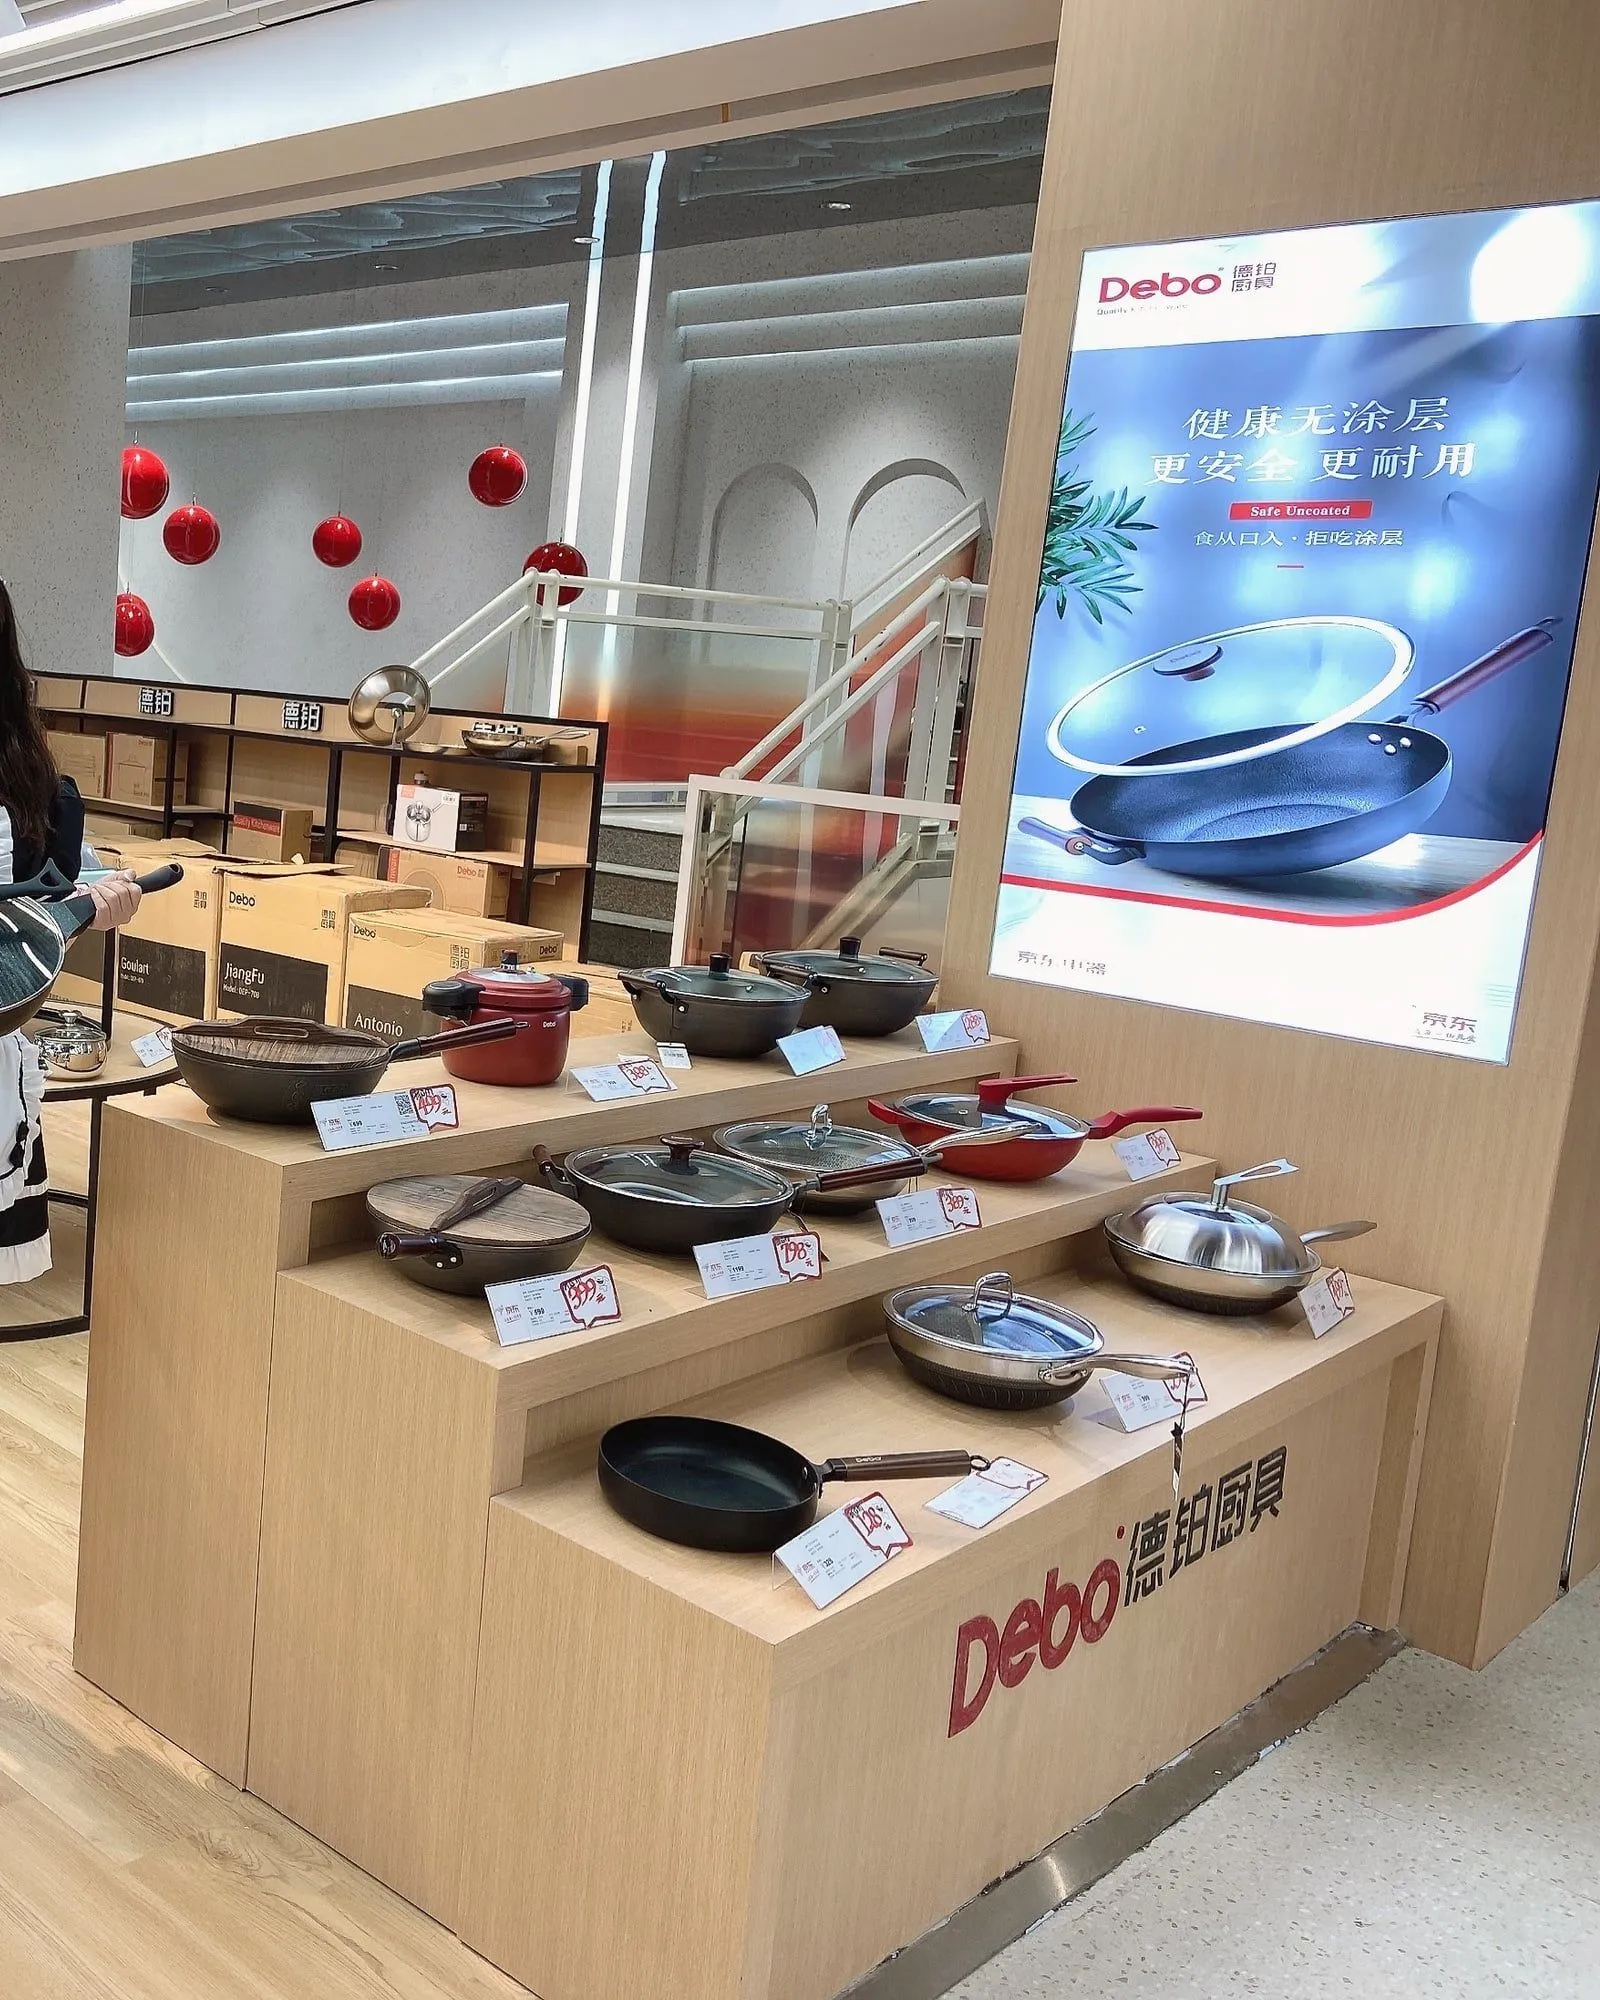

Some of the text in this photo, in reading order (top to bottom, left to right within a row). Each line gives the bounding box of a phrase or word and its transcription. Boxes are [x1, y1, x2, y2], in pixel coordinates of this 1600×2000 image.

[1098, 272, 1222, 303] Debo
[1182, 396, 1450, 441] 健康无涂层
[1143, 442, 1476, 486] 更安全 更耐用
[1250, 504, 1351, 518] Safe Uncoated
[138, 687, 174, 717] 德铂
[282, 701, 323, 732] 德铂
[457, 865, 477, 877] Debo
[229, 891, 256, 907] Debo
[353, 925, 376, 939] Debo
[539, 945, 557, 955] Debo
[120, 956, 150, 975] Goulart
[224, 962, 265, 985] JiangFu
[353, 1012, 404, 1037] Antonio
[542, 1021, 557, 1029] Debo
[1422, 1011, 1478, 1034] 京东
[857, 1506, 883, 1537] 128
[1124, 1446, 1287, 1608] 德铂厨具
[947, 1558, 1121, 1739] Debo
